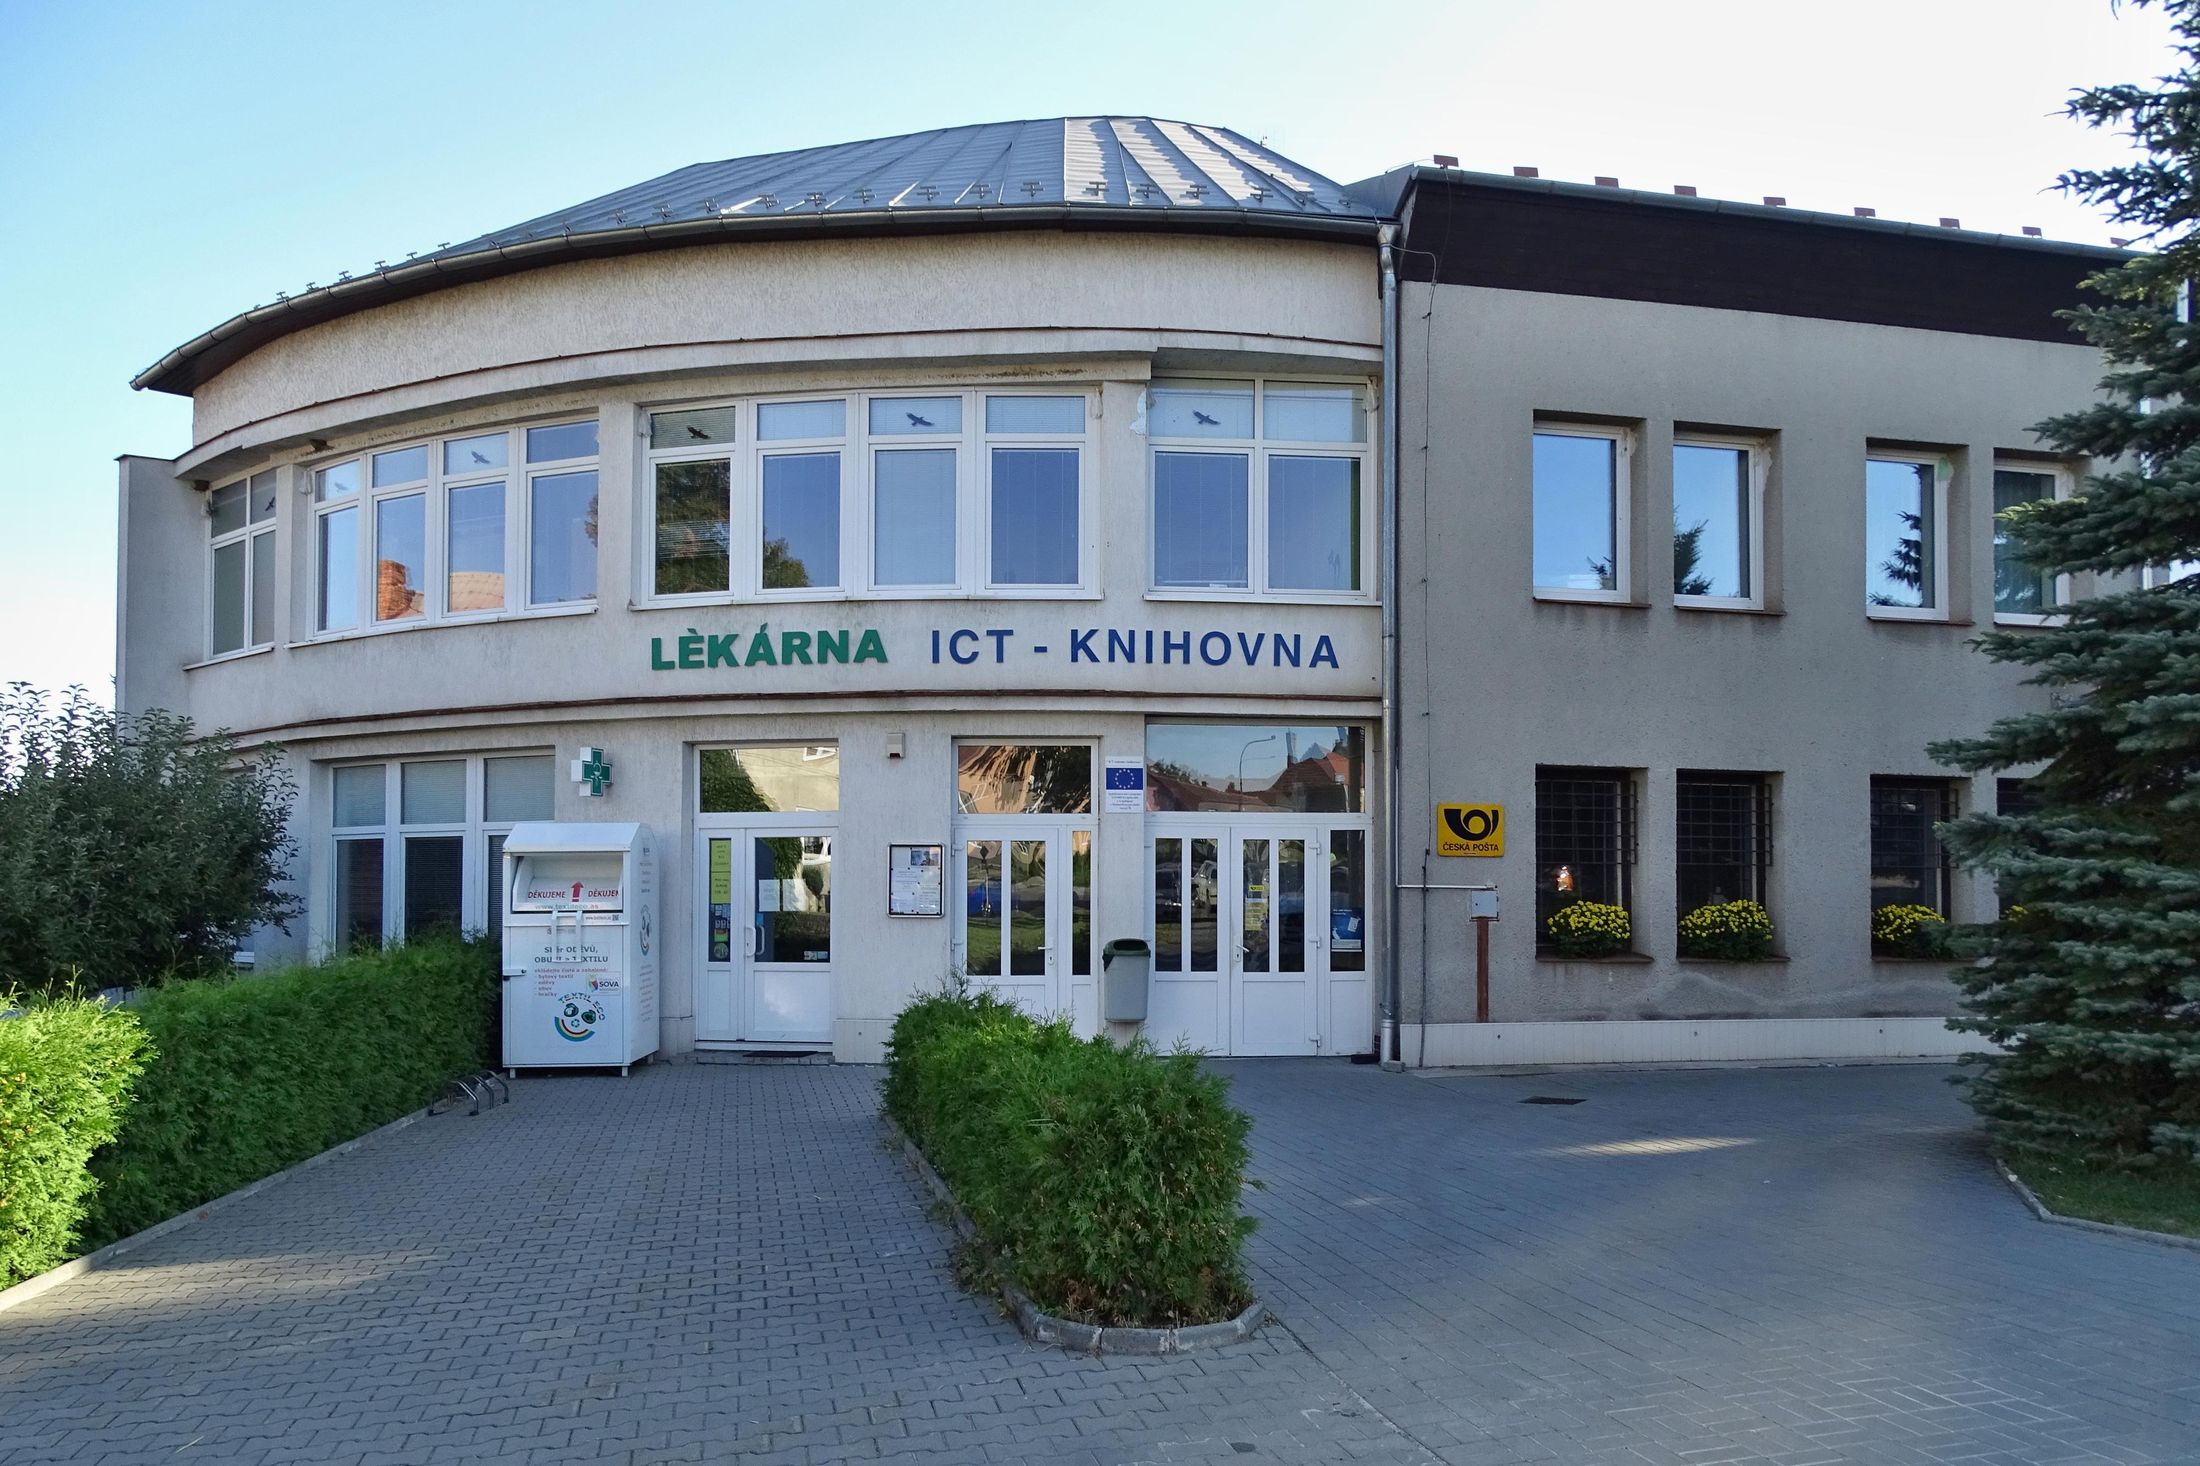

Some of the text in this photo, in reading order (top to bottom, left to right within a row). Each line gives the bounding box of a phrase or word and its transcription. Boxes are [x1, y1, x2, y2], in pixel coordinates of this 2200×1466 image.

[931, 629, 1014, 664] ICT
[1070, 629, 1340, 669] KNIHOVNA
[1442, 841, 1499, 852] ČESKÁ POŠTA
[527, 889, 567, 899] DĚKUJEME
